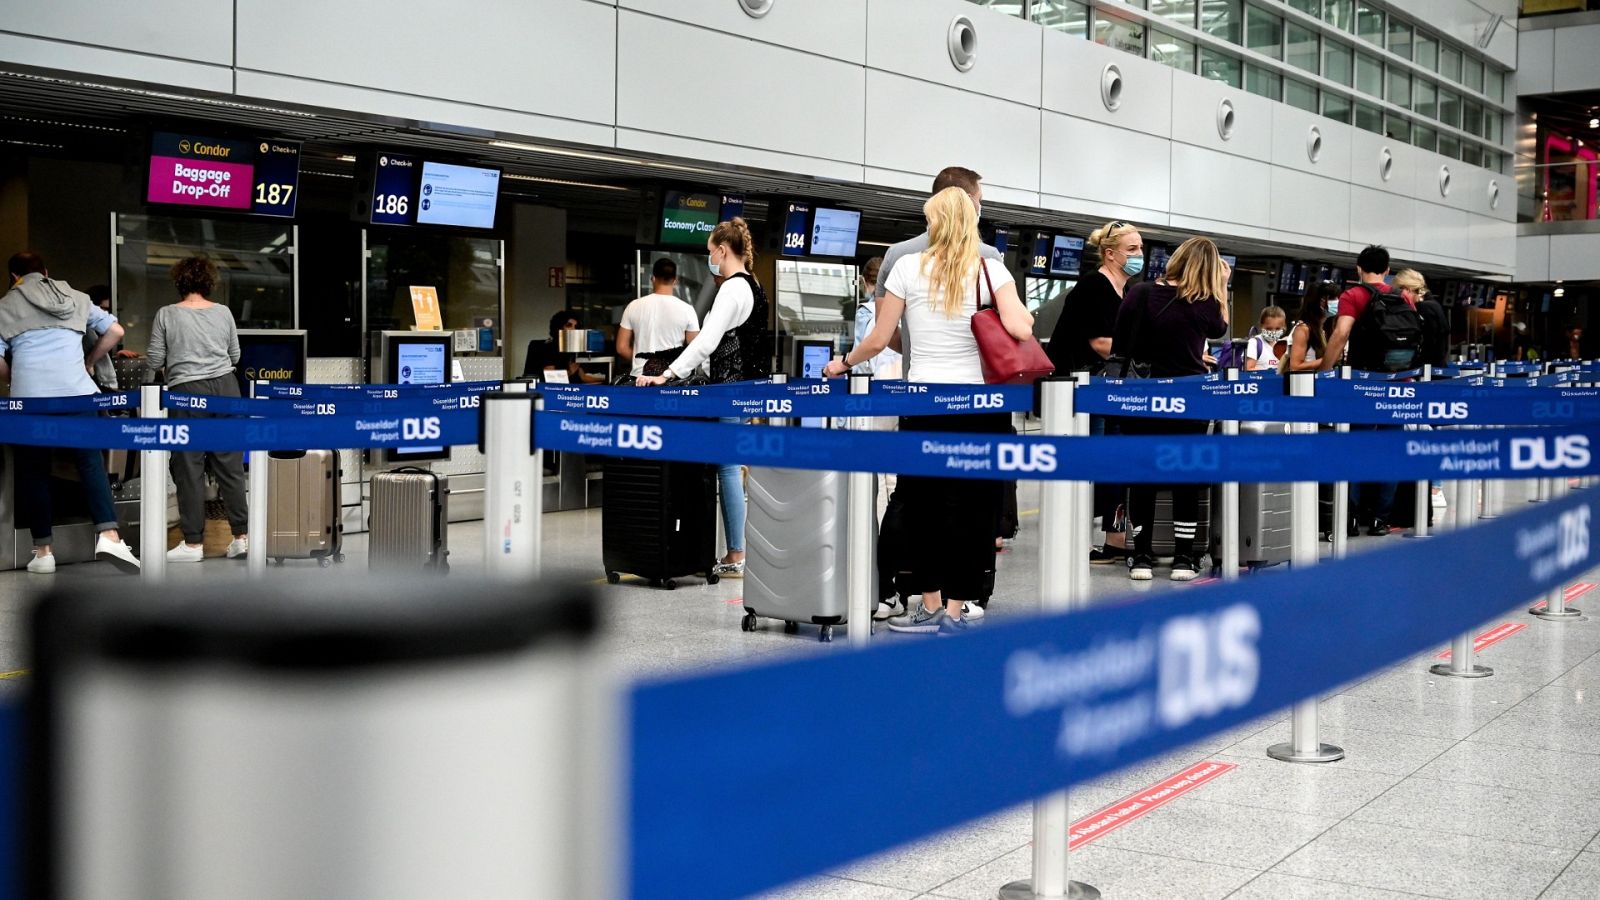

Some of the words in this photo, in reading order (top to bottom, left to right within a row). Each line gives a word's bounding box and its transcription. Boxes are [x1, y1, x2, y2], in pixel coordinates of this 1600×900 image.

[193, 142, 231, 157] Condor
[272, 145, 297, 154] Check-in
[390, 158, 413, 167] Check-in
[174, 163, 231, 183] Baggage
[172, 180, 231, 199] Drop-Off
[255, 182, 294, 205] 187
[375, 193, 409, 215] 186
[664, 218, 696, 233] Economy
[785, 233, 805, 249] 184
[1033, 255, 1048, 269] 182
[258, 368, 292, 380] Condor
[289, 387, 302, 396] DUS
[384, 389, 398, 399] DUS
[811, 385, 830, 394] DUS
[1234, 383, 1258, 395] DUS
[1389, 387, 1416, 398] DUS
[9, 400, 23, 410] DUS
[112, 395, 127, 406] DUS
[190, 397, 208, 409] DUS
[460, 395, 480, 408] DUS
[557, 394, 585, 402] Düsseldorf
[586, 395, 609, 409] DUS
[934, 395, 970, 403] Düsseldorf
[973, 393, 1004, 408] DUS
[1107, 394, 1148, 403] Düsseldorf
[1151, 396, 1186, 413] DUS
[317, 403, 336, 415] DUS
[766, 399, 792, 413] DUS
[947, 402, 970, 410] Airport
[1121, 403, 1148, 412] Airport
[1375, 402, 1423, 411] Düsseldorf
[1428, 402, 1468, 419] DUS
[1392, 410, 1423, 419] Airport
[122, 424, 157, 434] Düsseldorf
[356, 419, 399, 430] Düsseldorf
[403, 417, 440, 440] DUS
[560, 419, 613, 434] Düsseldorf
[133, 435, 157, 445] Airport
[160, 425, 190, 444] DUS
[370, 431, 399, 441] Airport
[578, 434, 613, 448] Airport
[617, 424, 662, 451] DUS
[922, 440, 991, 455] Düsseldorf
[1406, 439, 1499, 456] Düsseldorf
[1509, 435, 1591, 470] DUS
[947, 455, 991, 471] Airport
[998, 443, 1057, 472] DUS
[1440, 456, 1500, 473] Airport
[1157, 603, 1262, 728] DUS
